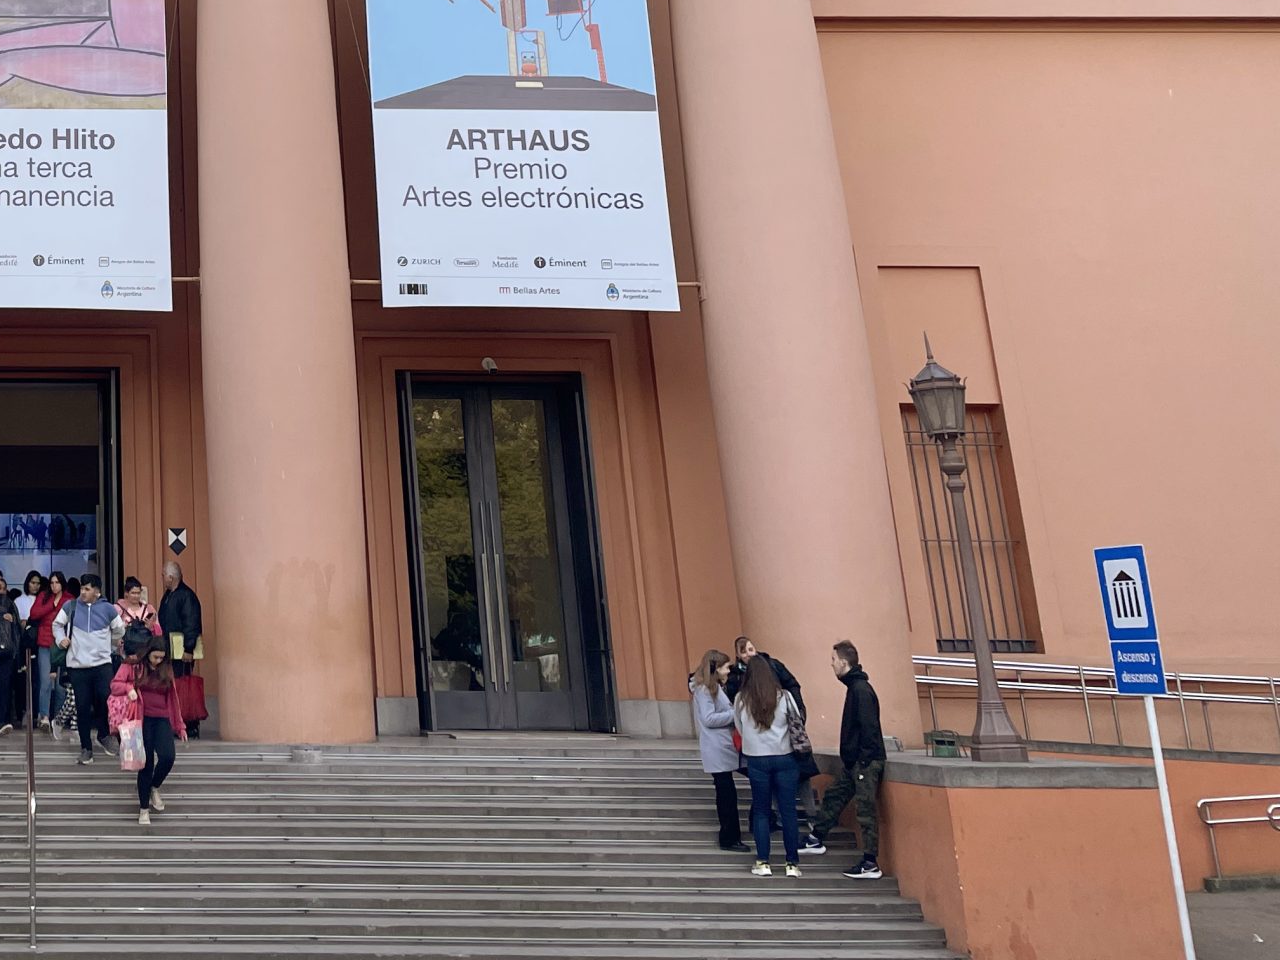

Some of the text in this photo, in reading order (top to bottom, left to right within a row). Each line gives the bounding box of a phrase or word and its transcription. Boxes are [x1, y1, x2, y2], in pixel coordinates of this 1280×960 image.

[52, 128, 116, 150] Hlito
[446, 128, 590, 152] ARTHAUS
[26, 157, 93, 179] terca
[474, 157, 568, 180] Premio
[402, 184, 644, 210] Artes electrónicas
[47, 255, 85, 265] Éminent
[411, 258, 441, 266] ZURICH
[549, 257, 587, 267] Éminent
[116, 290, 142, 298] Argentina
[513, 286, 561, 295] Bellas Artes
[1117, 650, 1156, 666] Ascenso y
[1121, 670, 1159, 684] descenso
